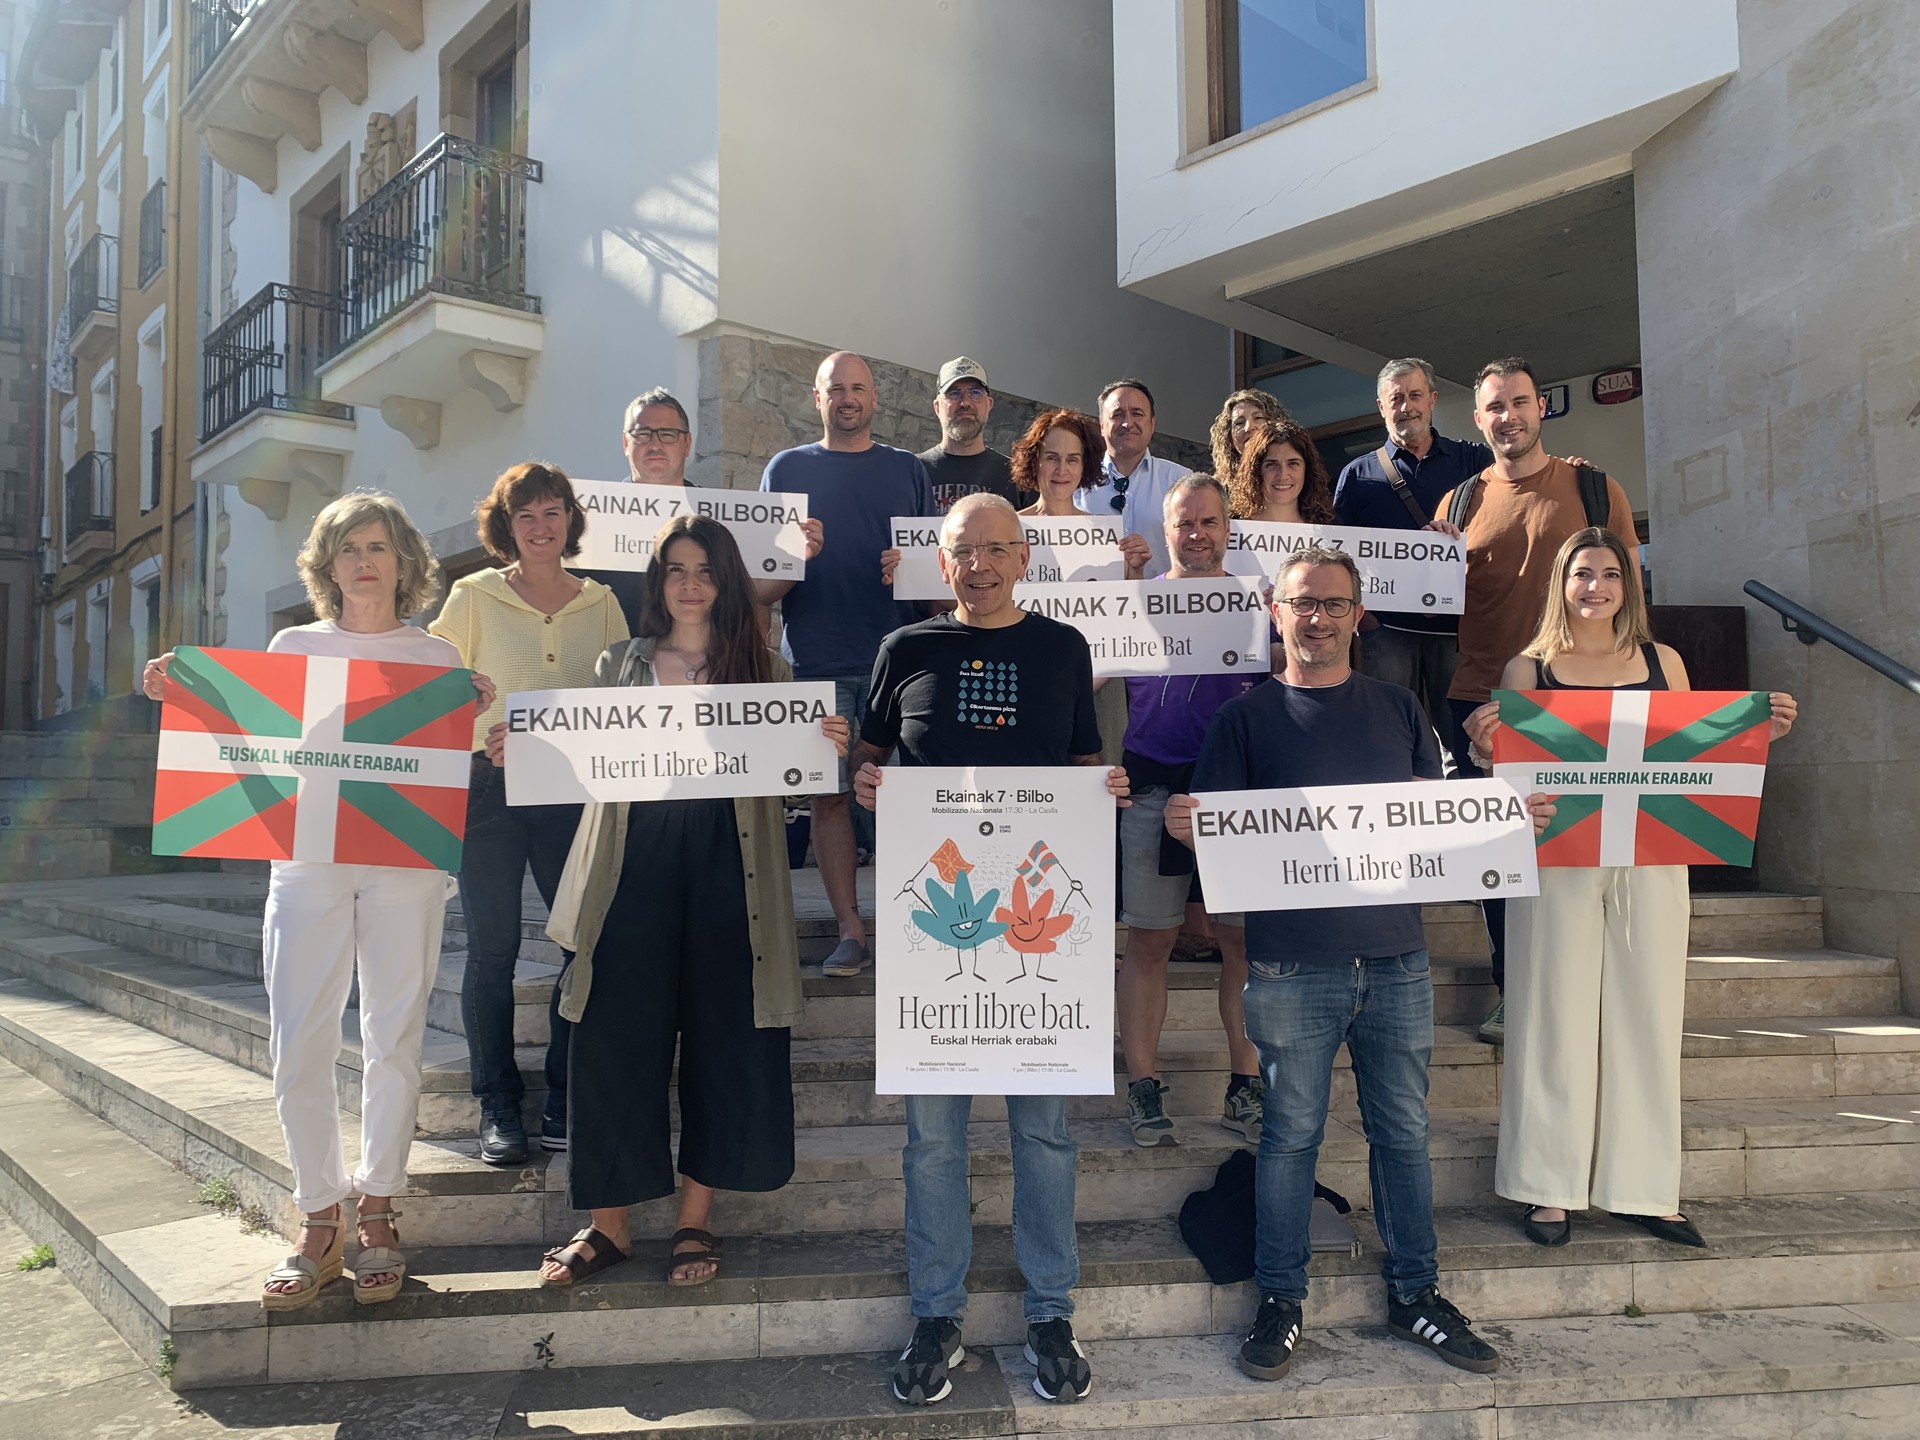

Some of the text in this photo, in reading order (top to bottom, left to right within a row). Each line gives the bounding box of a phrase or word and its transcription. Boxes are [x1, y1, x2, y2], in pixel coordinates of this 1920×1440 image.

[1598, 375, 1632, 391] SUA
[575, 494, 660, 517] AINAK
[697, 501, 801, 525] BILBORA
[614, 534, 657, 554] Herri
[1025, 528, 1119, 546] BILBORA
[1358, 540, 1461, 563] BILBORA
[1038, 564, 1062, 582] Bat
[1369, 576, 1396, 595] Bat
[1116, 596, 1137, 619] 7,
[1147, 591, 1263, 615] BILBORA
[1112, 636, 1157, 658] Libre
[1163, 635, 1193, 656] Bat
[509, 699, 828, 733] EKAINAK 7, BILBORA
[219, 746, 420, 773] EUSKAL HERRIAK ERABAKI
[591, 750, 750, 779] Herri Libre Bat
[1536, 772, 1714, 786] EUSKAL HERRIAK ERABAKI
[936, 789, 995, 803] Ekainak
[997, 790, 1006, 803] 7
[1017, 789, 1055, 803] Bilbo
[1197, 796, 1527, 837] EKAINAK 7, BILBORA
[1282, 852, 1447, 884] Herri Libre Bat
[898, 992, 1091, 1030] Herri libre bat.
[930, 1035, 1058, 1046] Euskal Herriak erabaki
